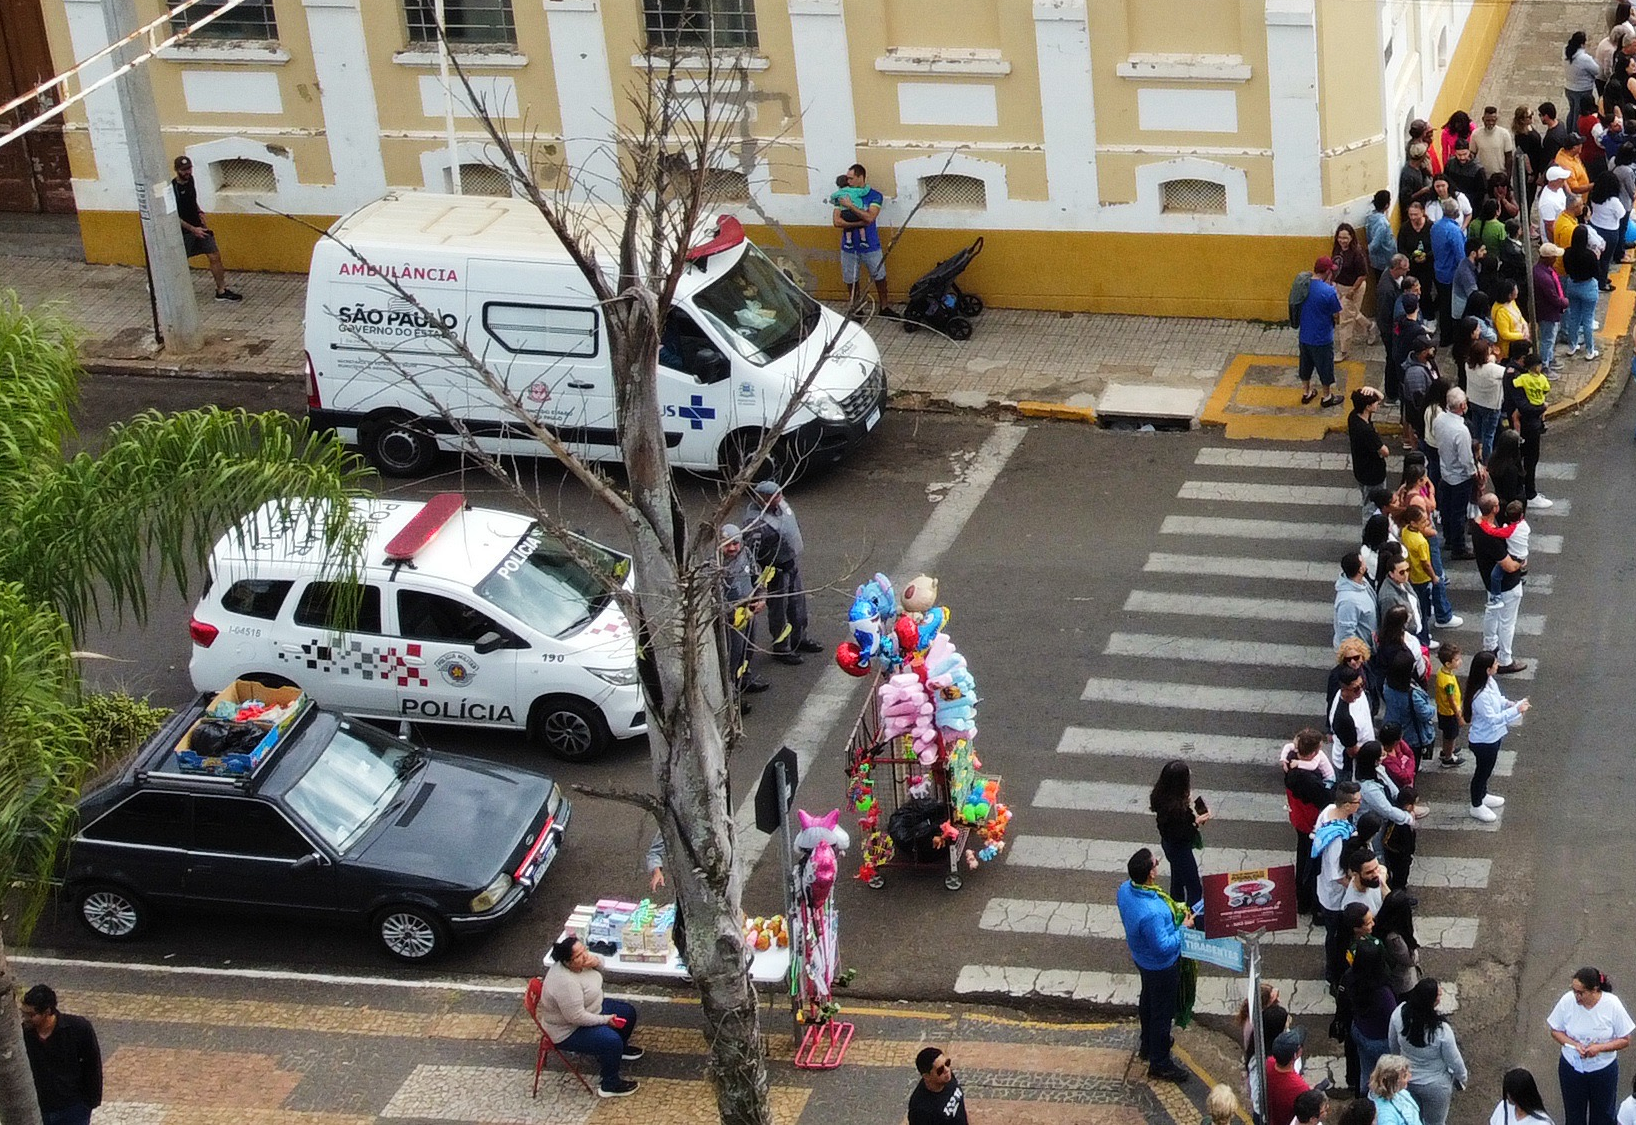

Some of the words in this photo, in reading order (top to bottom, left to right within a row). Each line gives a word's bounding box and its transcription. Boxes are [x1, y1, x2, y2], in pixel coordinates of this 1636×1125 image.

[339, 262, 458, 282] AMBULÂNCIA
[339, 303, 383, 326] SÃO
[338, 323, 394, 336] GOVERNO
[395, 327, 412, 337] DO
[496, 535, 542, 580] POLÍCIA
[542, 653, 565, 663] 190
[401, 698, 516, 723] POLÍCIA
[1184, 940, 1239, 961] TIRADENTES
